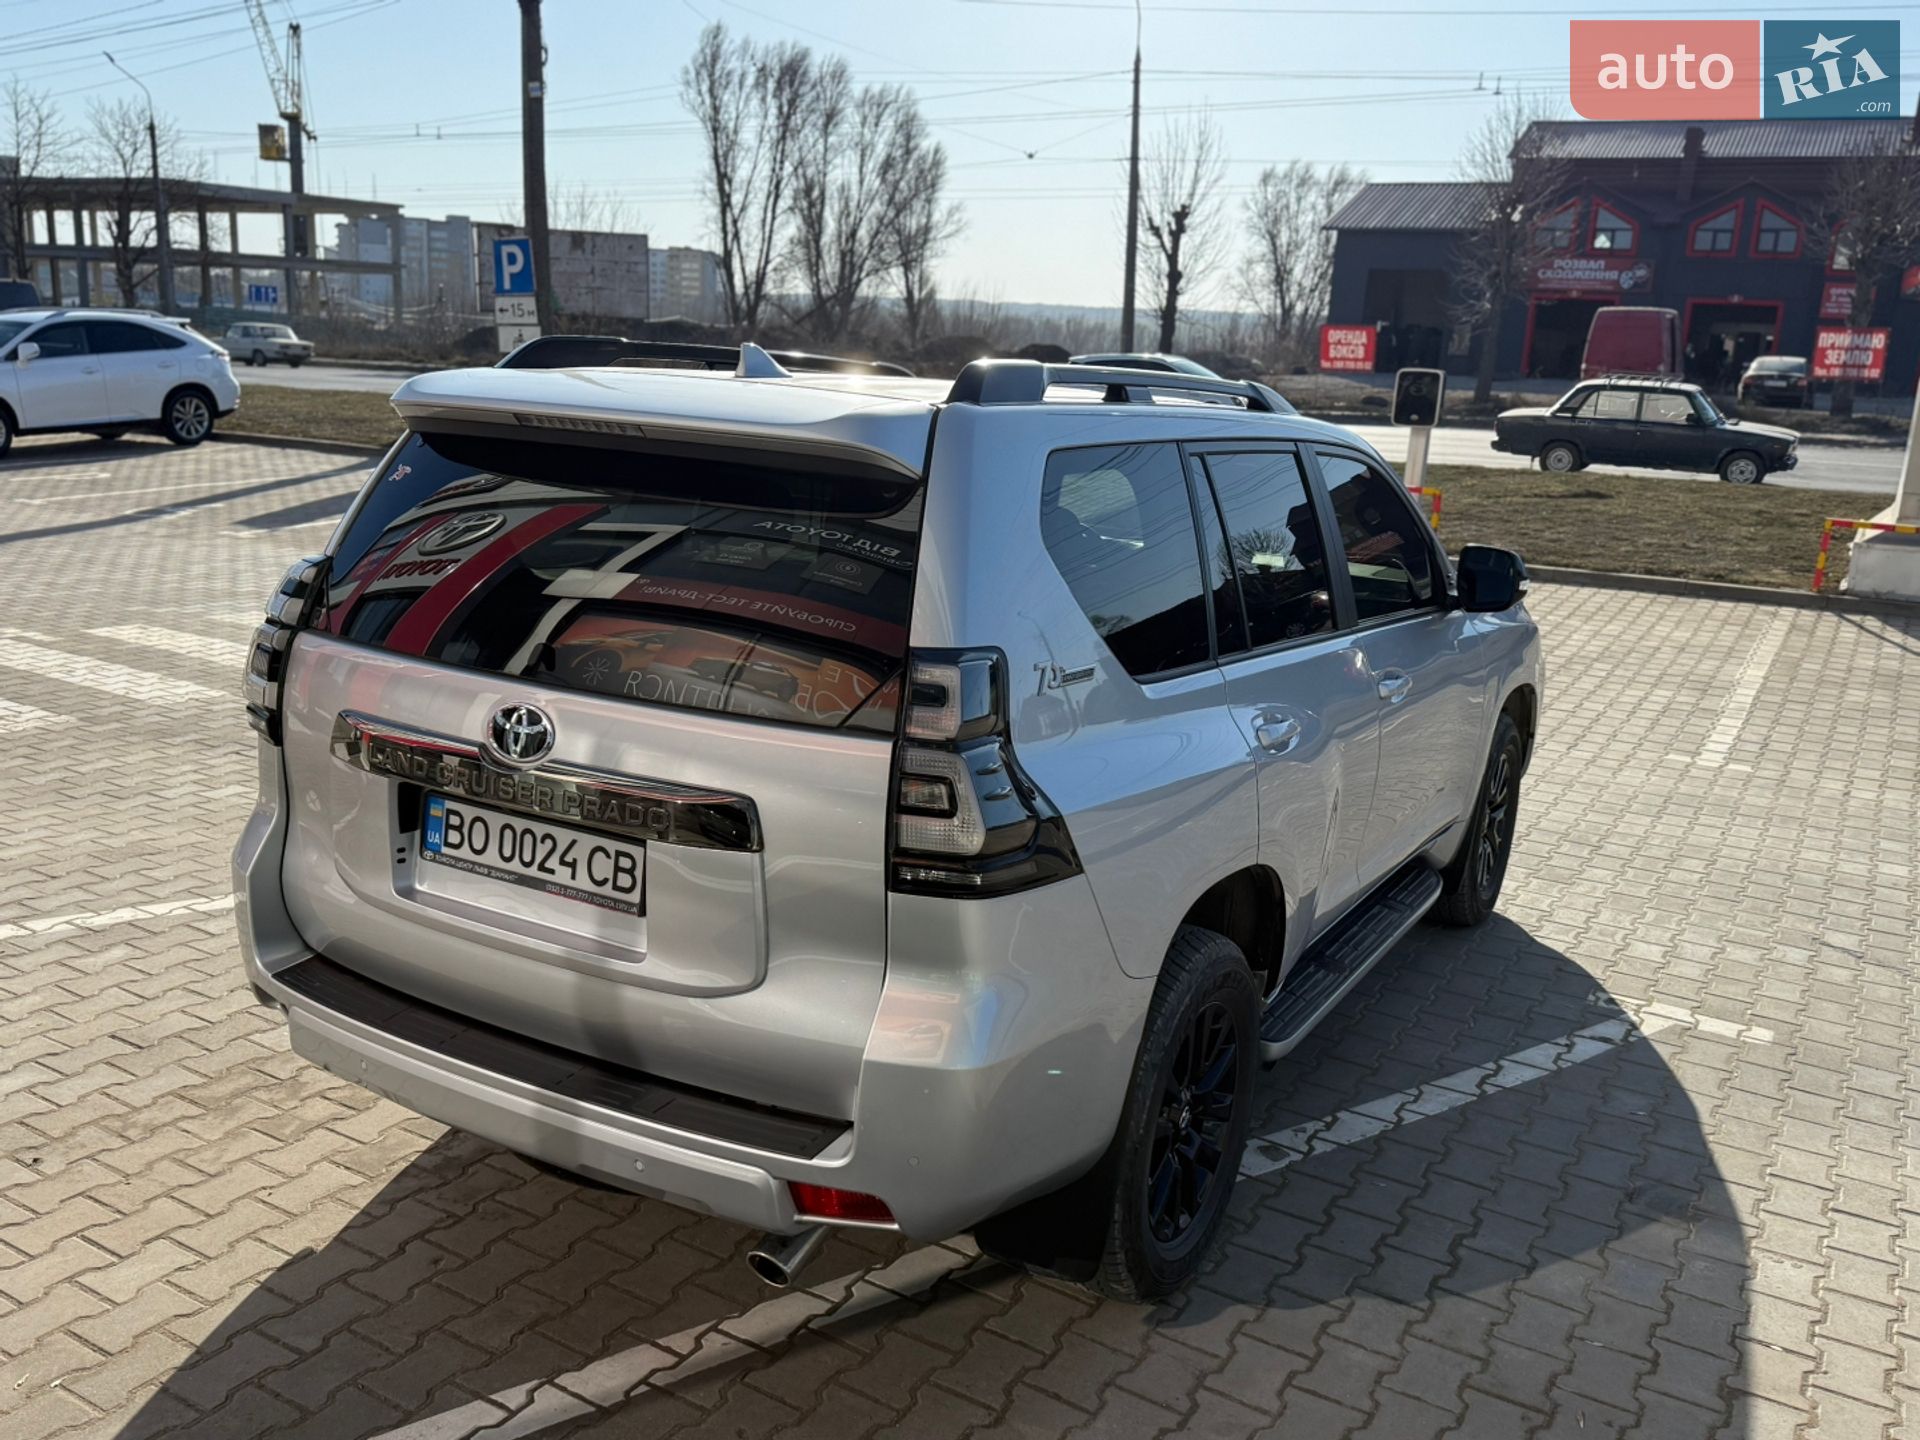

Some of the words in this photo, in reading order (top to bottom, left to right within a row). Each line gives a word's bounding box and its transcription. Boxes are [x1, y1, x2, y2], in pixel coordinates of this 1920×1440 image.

[501, 244, 524, 290] P
[1553, 259, 1605, 269] РОЗВАЛ
[1537, 269, 1619, 281] СХОДЖЕННЯ
[511, 303, 525, 318] 15
[1328, 329, 1367, 345] ОРЕНДА
[1818, 329, 1886, 349] ПРИЙМАЮ
[1329, 345, 1365, 359] БОКСІВ
[1824, 349, 1873, 366] ЗЕМЛЮ
[370, 745, 429, 779] LAND
[436, 762, 554, 810] CRUISER
[563, 789, 671, 832] PRADO
[427, 829, 441, 845] UA
[443, 808, 490, 856] BO
[498, 823, 579, 880] 0024
[586, 845, 638, 894] CB
